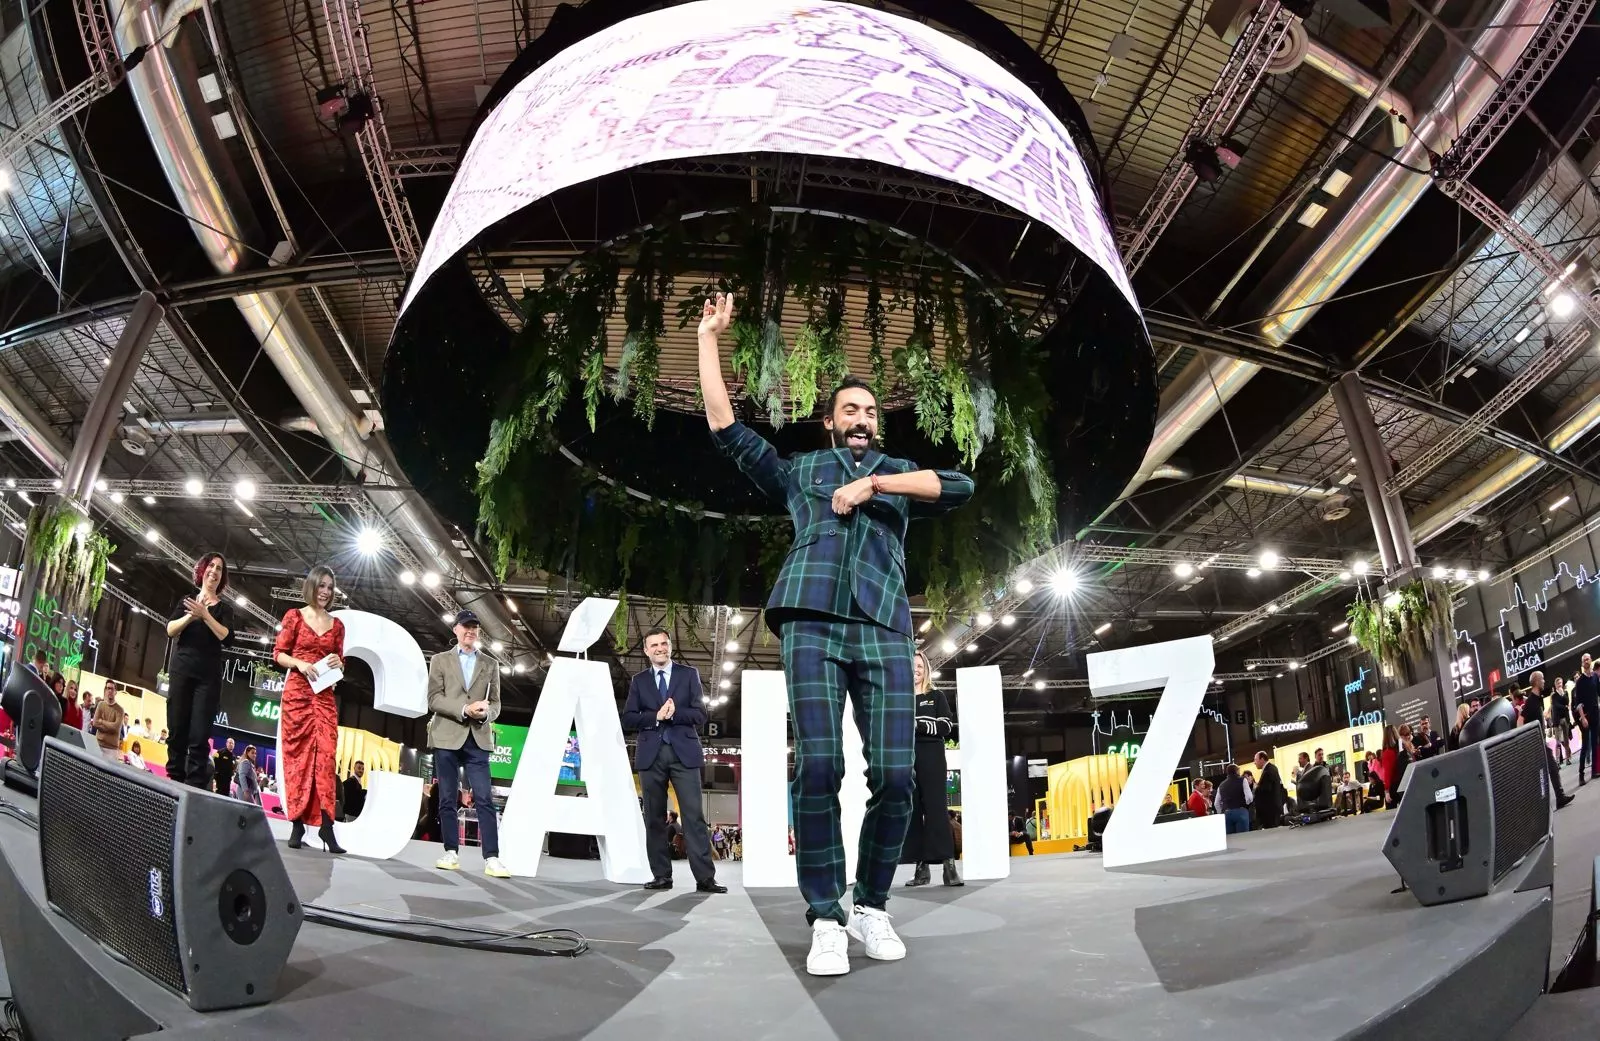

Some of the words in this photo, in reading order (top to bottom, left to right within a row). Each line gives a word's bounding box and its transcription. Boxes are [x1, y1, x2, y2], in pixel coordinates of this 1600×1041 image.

[1505, 642, 1536, 663] COSTA
[1507, 653, 1541, 673] MÁLAGA
[214, 712, 229, 725] VA
[708, 723, 718, 736] B
[1261, 721, 1308, 735] SHOWCOOKING
